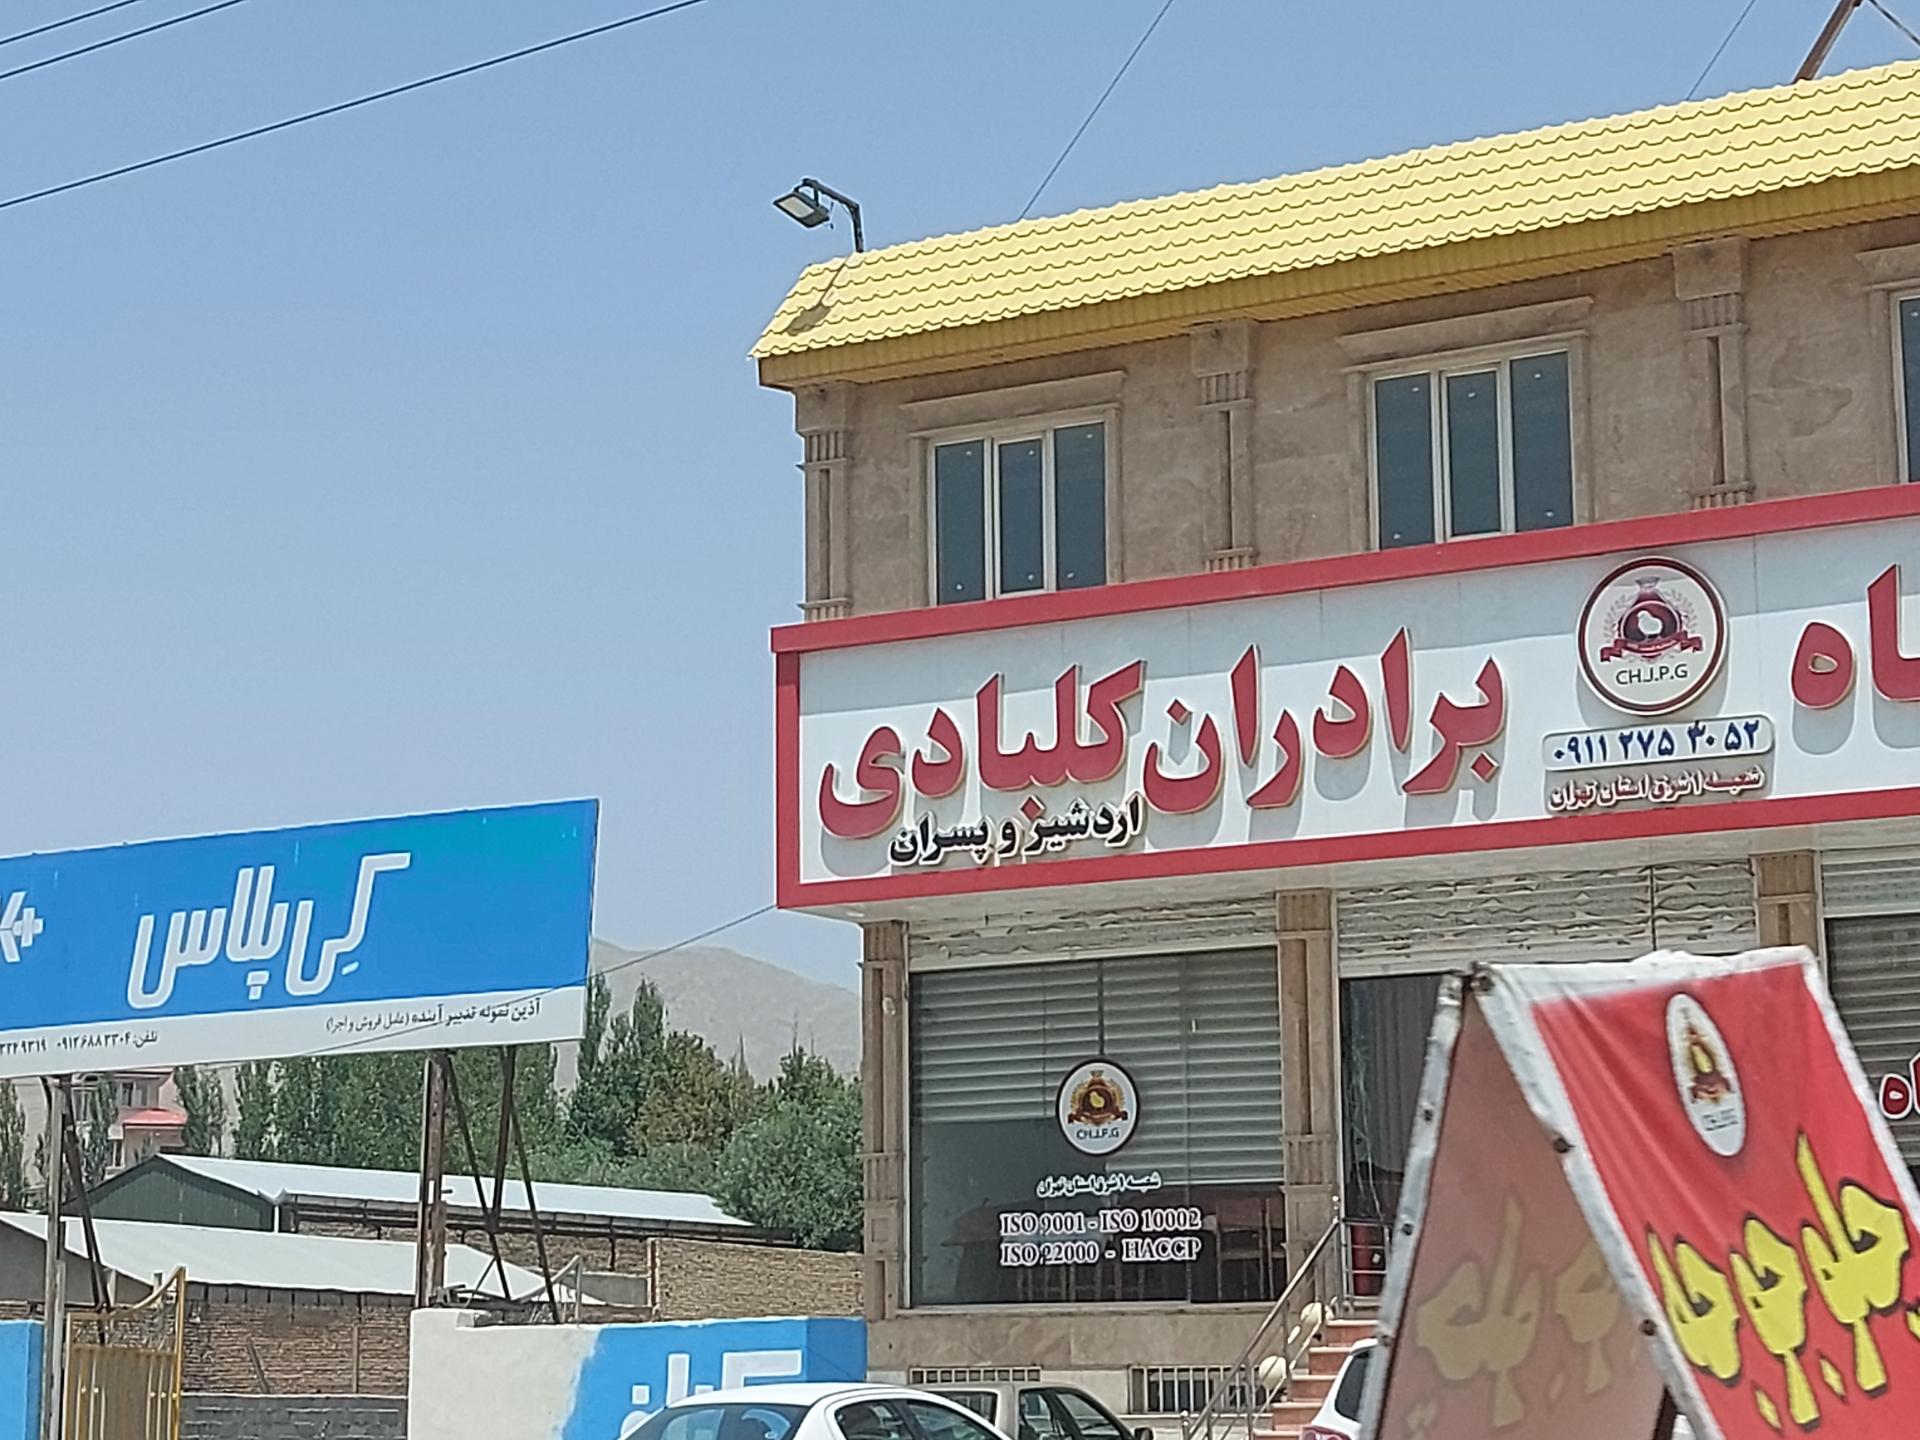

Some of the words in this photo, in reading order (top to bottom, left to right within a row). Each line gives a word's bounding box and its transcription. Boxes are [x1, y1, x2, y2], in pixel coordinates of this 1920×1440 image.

[1143, 626, 1505, 815] برادران
[1549, 780, 1599, 812] تهران
[1600, 774, 1650, 807] استان
[890, 813, 991, 864] پسران
[997, 817, 1019, 856] و
[1024, 796, 1144, 855] اردشیر
[126, 865, 290, 1009] پلاس
[1000, 1212, 1038, 1236] ISO
[1039, 1211, 1086, 1236] 9001
[1099, 1208, 1139, 1234] ISO
[1141, 1207, 1202, 1232] 10002
[1000, 1243, 1038, 1267] ISO
[1039, 1241, 1100, 1265] 22000
[1121, 1237, 1202, 1262] HACCP
